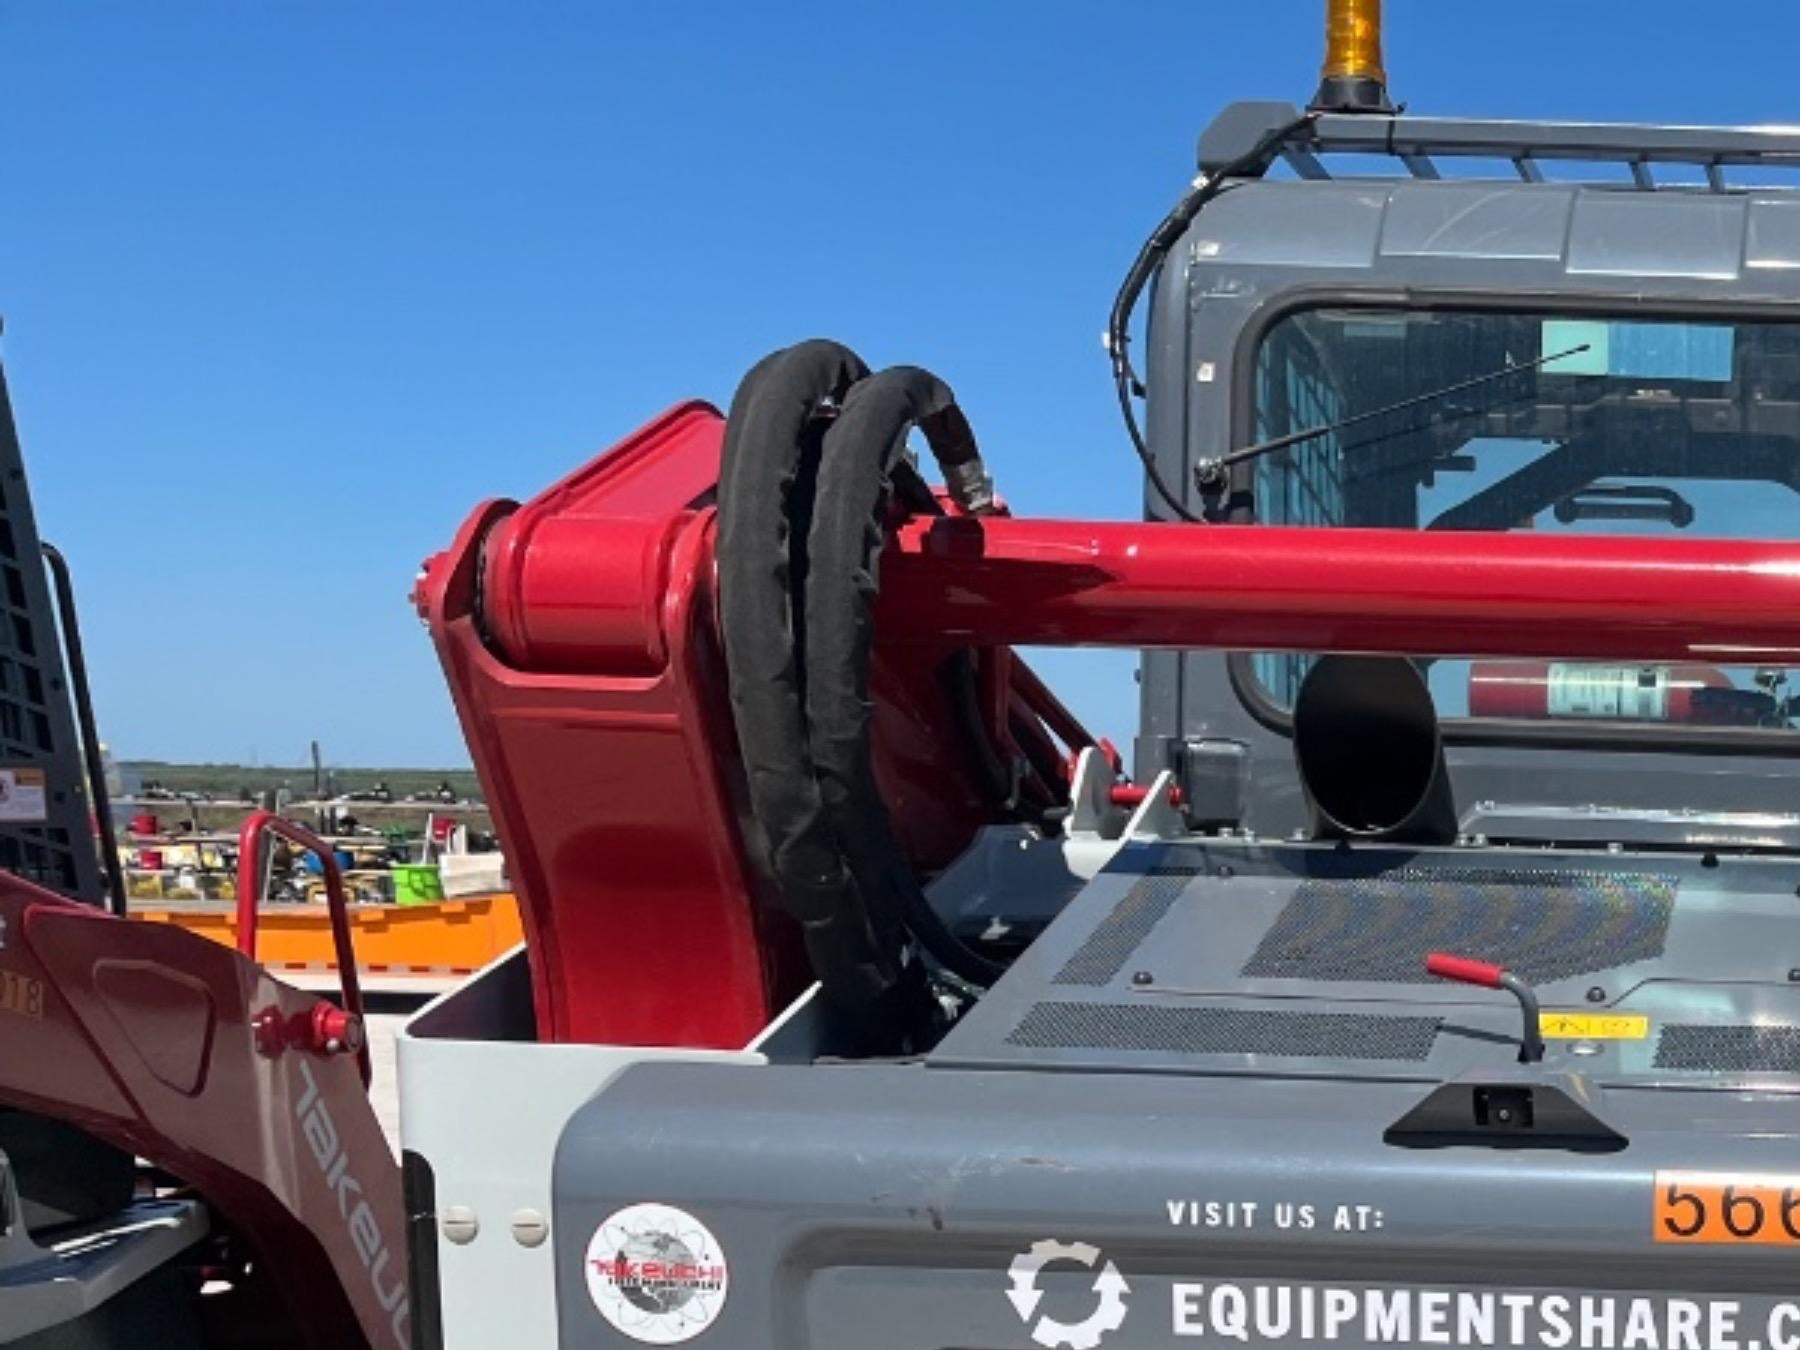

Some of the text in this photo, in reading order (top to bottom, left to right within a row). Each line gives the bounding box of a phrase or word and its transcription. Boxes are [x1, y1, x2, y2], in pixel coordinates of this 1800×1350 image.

[1166, 1200, 1384, 1231] VISIT US AT:
